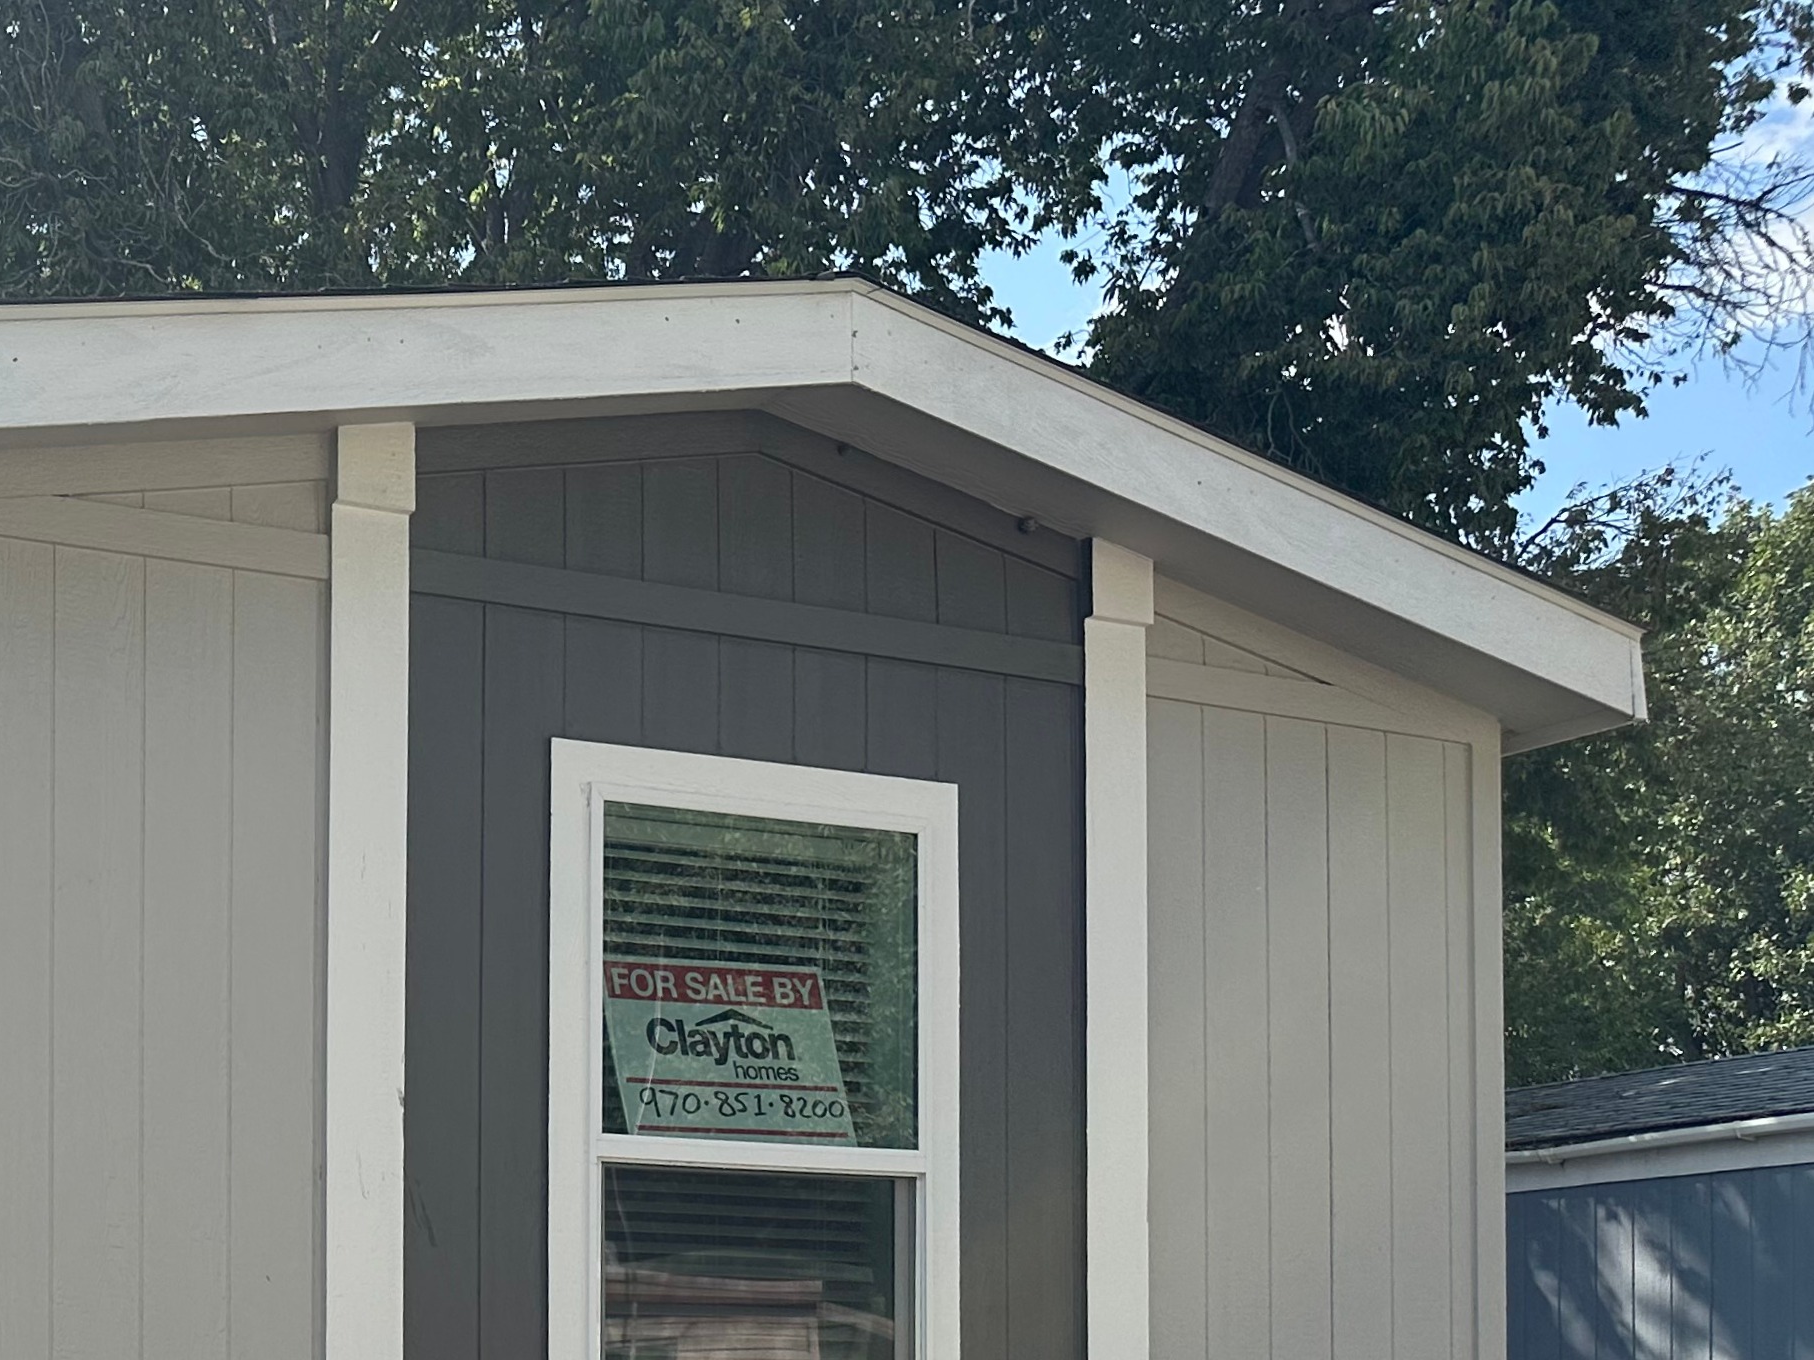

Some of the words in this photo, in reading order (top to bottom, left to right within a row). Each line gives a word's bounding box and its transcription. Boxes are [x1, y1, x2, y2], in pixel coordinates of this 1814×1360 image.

[610, 967, 678, 998] FOR
[685, 971, 766, 1003] SALE
[772, 977, 813, 1006] BY
[646, 1017, 796, 1066] Clayton
[734, 1060, 800, 1082] homes
